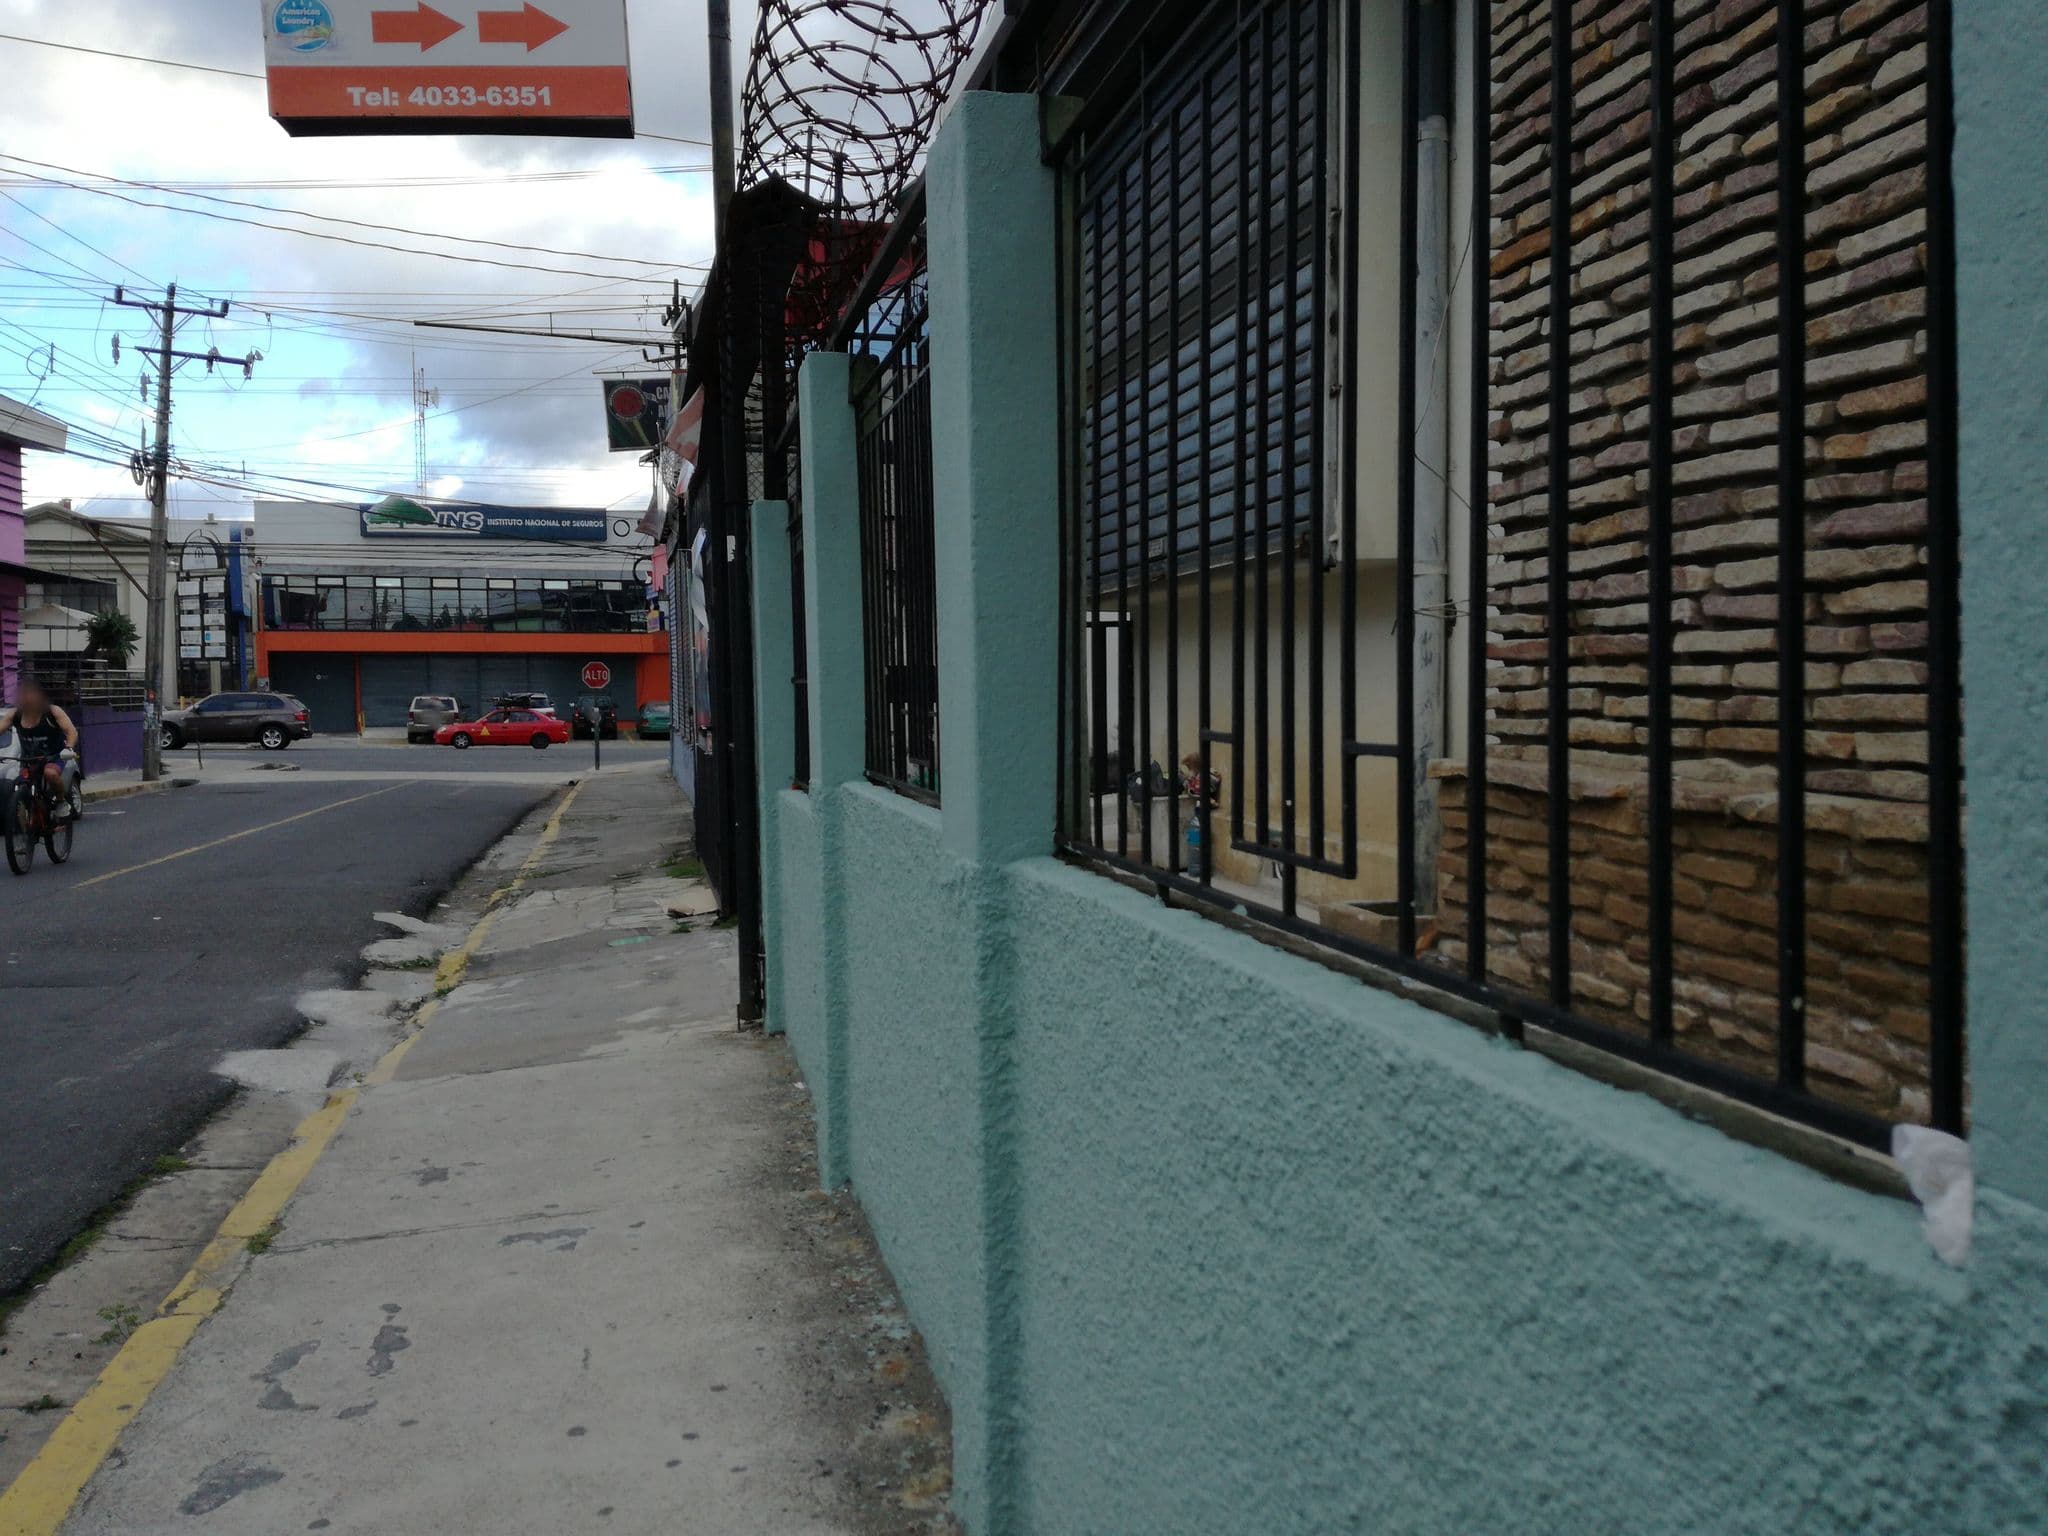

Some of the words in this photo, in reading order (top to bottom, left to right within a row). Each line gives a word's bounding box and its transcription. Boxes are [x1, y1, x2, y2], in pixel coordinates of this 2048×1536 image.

[346, 86, 399, 107] Tel:
[408, 85, 552, 107] 4033-6351
[437, 511, 484, 529] INS
[487, 518, 523, 527] INSTITUTO
[525, 519, 560, 527] NACIONAL
[572, 520, 604, 528] SEGUROS
[584, 669, 608, 681] ALTO
